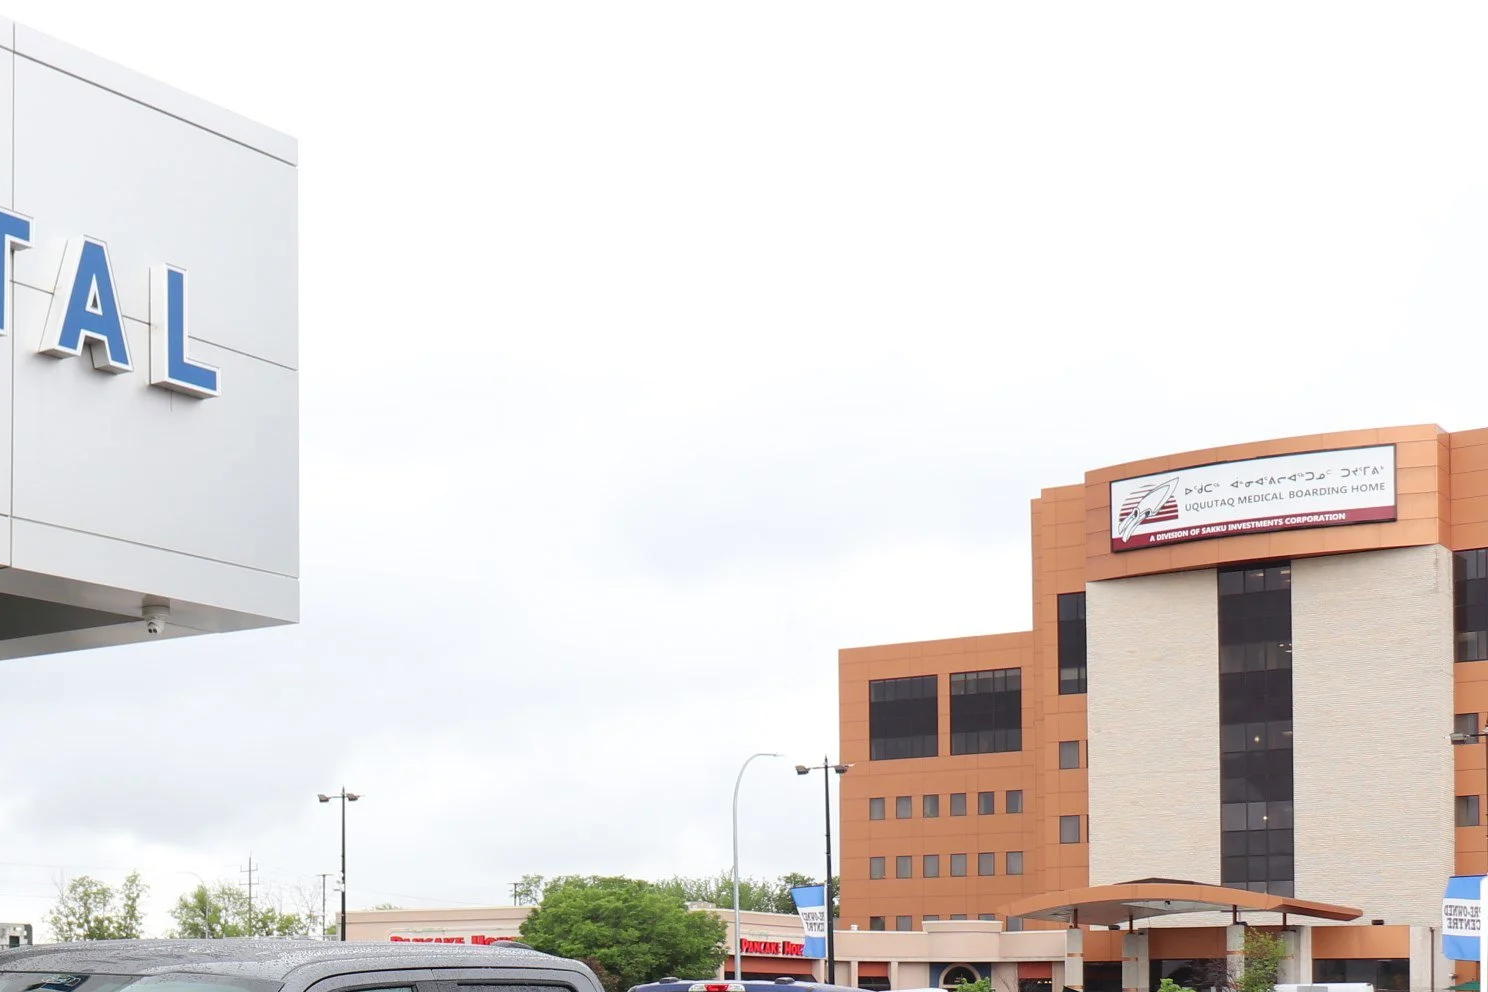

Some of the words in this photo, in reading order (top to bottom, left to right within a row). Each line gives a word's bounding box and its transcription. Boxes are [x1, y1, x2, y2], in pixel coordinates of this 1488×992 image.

[1184, 497, 1235, 512] UQUUTAQ
[1237, 491, 1284, 504] MEDICAL
[1288, 485, 1348, 499] BOARDING
[1351, 482, 1385, 493] HOME
[1157, 530, 1189, 541] DIVISION
[1190, 528, 1201, 536] OF
[1201, 525, 1227, 535] SAKKU
[1228, 518, 1284, 532] INVESTMENTS
[1284, 512, 1346, 525] CORPORATION
[740, 938, 782, 955] PANCAKE
